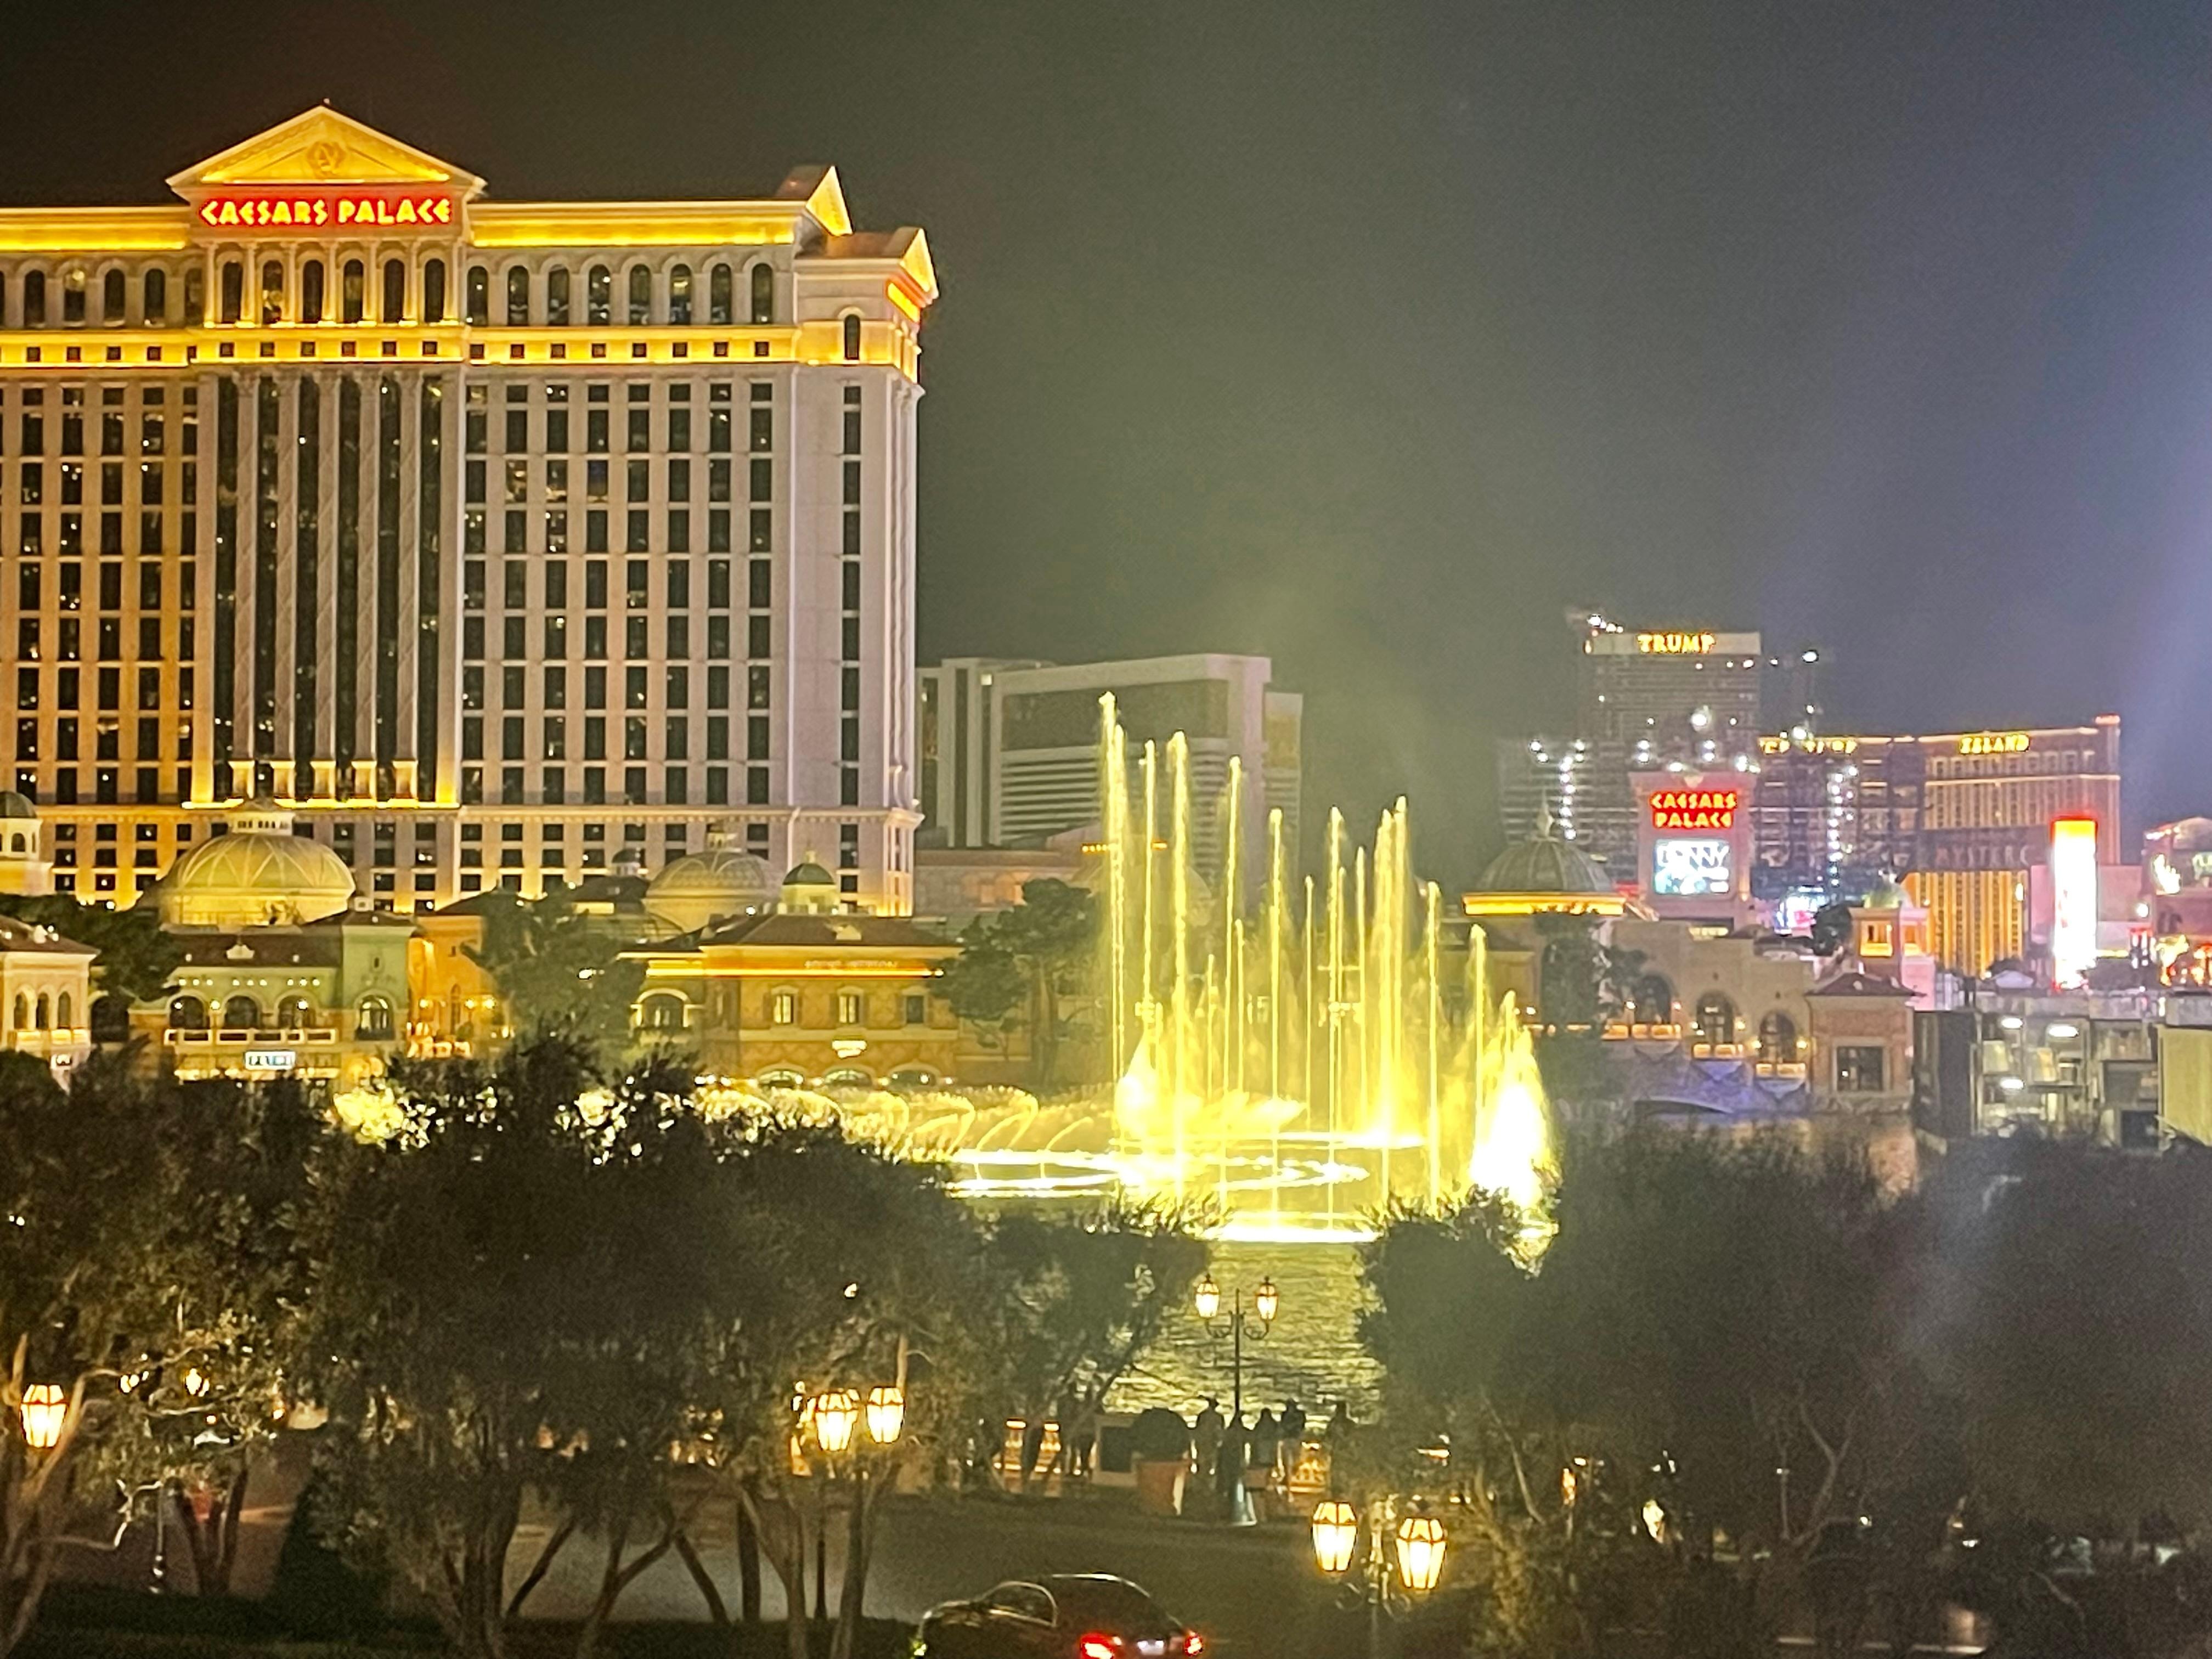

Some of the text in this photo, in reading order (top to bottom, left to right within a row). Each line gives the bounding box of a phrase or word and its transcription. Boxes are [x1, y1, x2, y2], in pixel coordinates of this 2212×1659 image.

[200, 198, 451, 226] CAESARS PALACE
[1637, 634, 1716, 653] TRUMP
[1960, 734, 2030, 754] ISLAND
[1651, 792, 1737, 809] CAESARS
[1655, 811, 1733, 828] PALACE
